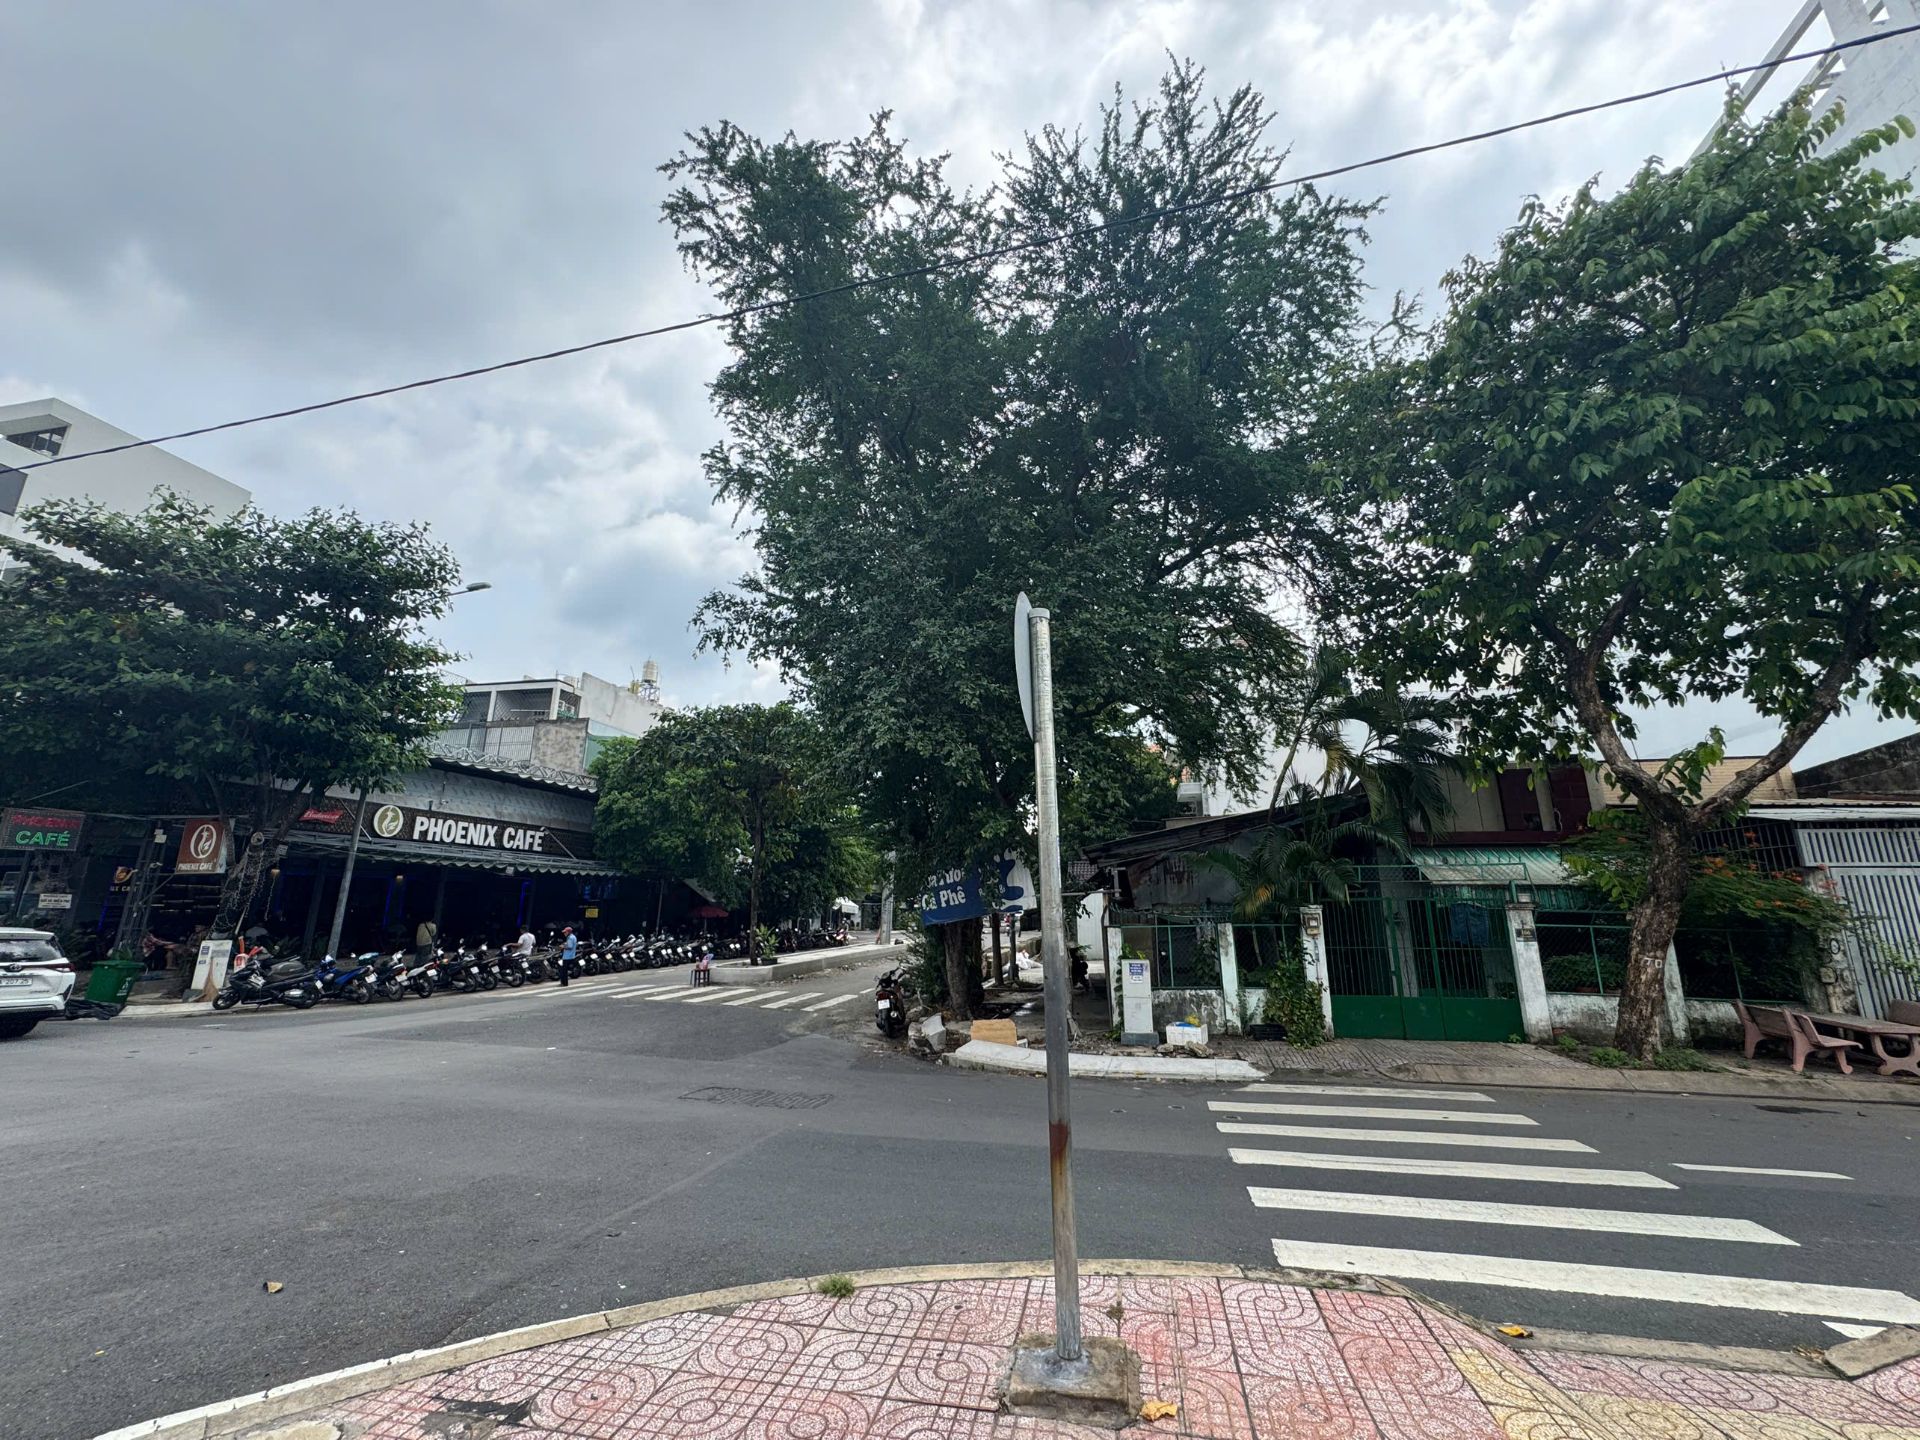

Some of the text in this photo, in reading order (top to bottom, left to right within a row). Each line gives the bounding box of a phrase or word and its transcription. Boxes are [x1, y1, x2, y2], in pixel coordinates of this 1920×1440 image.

[16, 830, 70, 847] CAFÉ
[413, 816, 546, 851] PHOENIX CAFÉ
[939, 886, 966, 908] Phê
